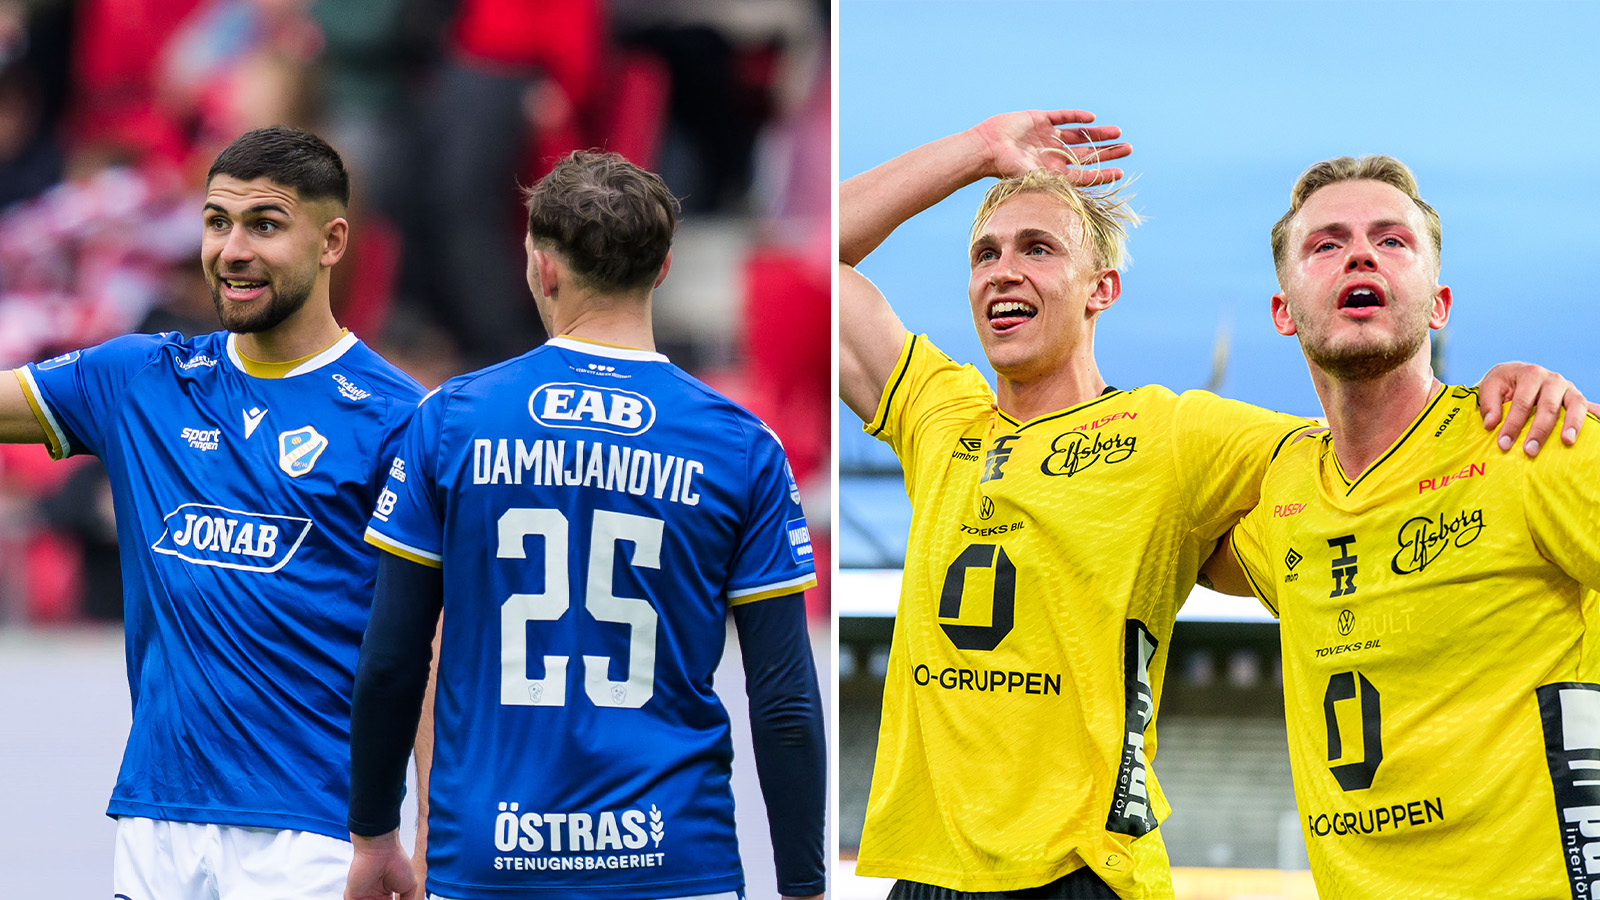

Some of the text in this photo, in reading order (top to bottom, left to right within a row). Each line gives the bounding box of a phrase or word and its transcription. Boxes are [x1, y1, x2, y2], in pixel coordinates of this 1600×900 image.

[541, 388, 644, 429] EAB
[180, 427, 221, 442] sport
[1040, 432, 1138, 478] Elfsborg
[473, 438, 704, 506] DAMNJANOVIC
[952, 451, 979, 462] umbro
[173, 513, 279, 558] JONAB
[1010, 520, 1025, 531] BIL
[1391, 508, 1487, 576] Elfsborg
[496, 507, 665, 709] 25
[1315, 639, 1382, 658] TOVEKS BIL
[911, 664, 1062, 696] O-GRUPPEN
[1114, 750, 1134, 817] interiör
[495, 802, 647, 852] ÖSTRAS
[493, 853, 665, 871] STENUGNSBAGERIET
